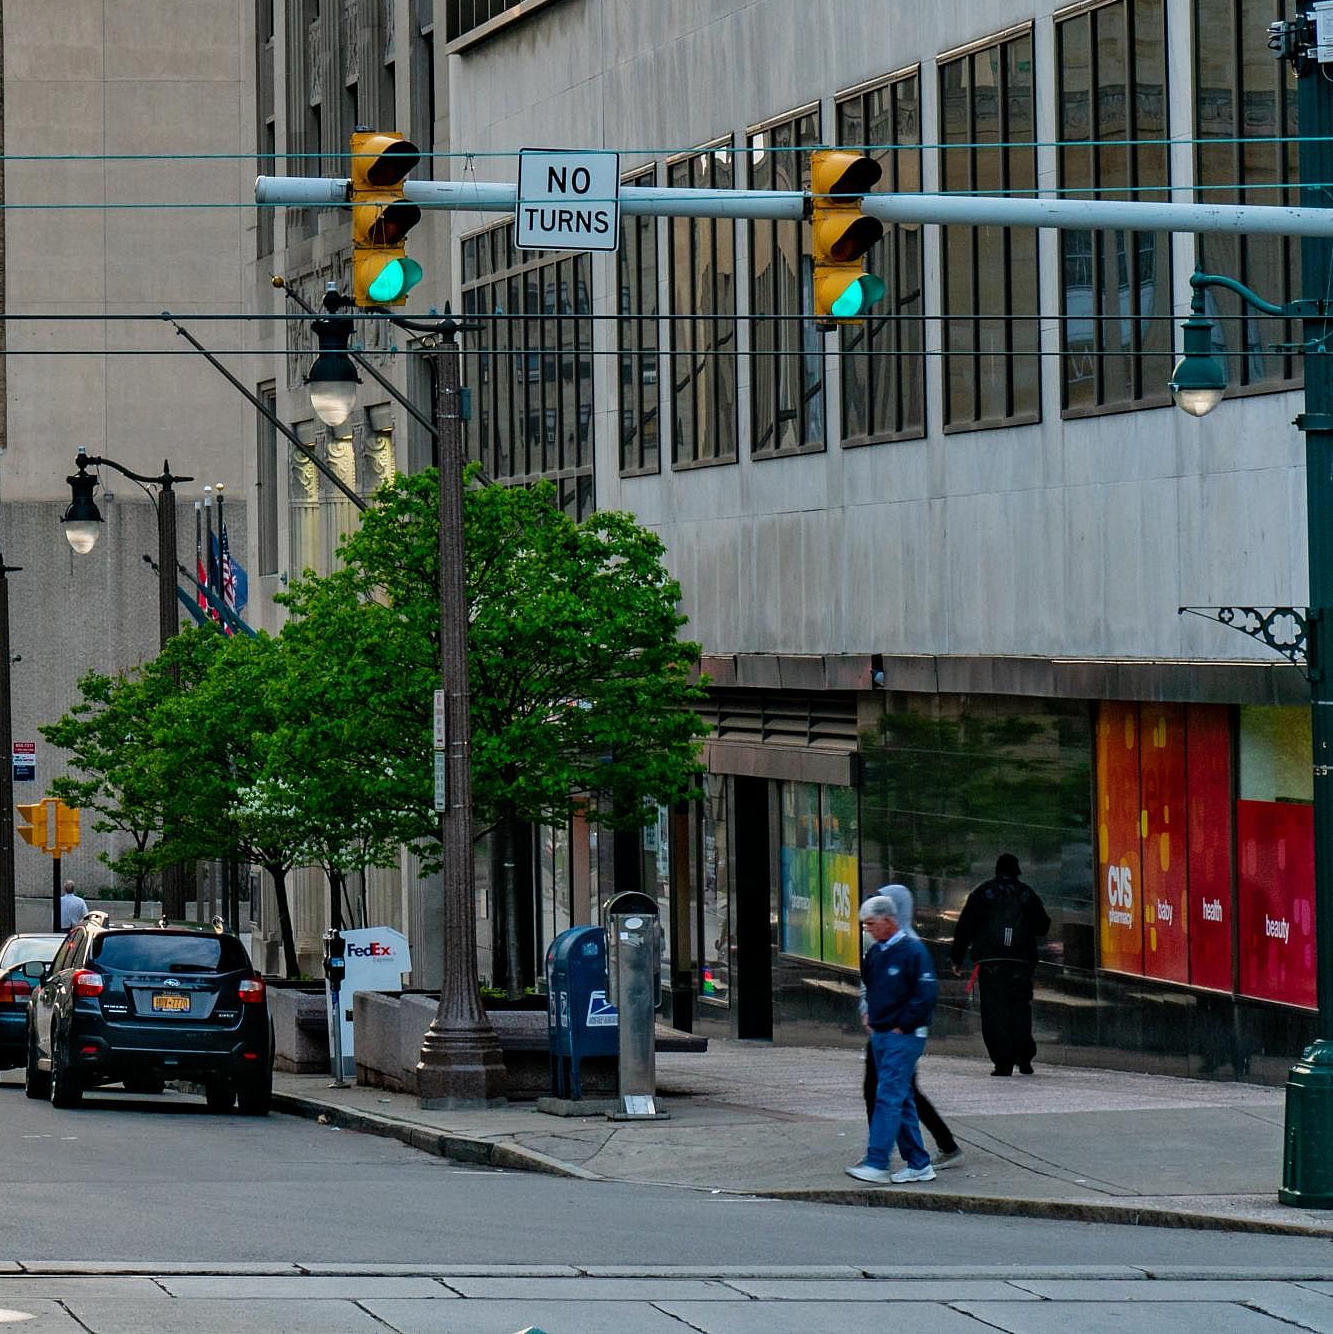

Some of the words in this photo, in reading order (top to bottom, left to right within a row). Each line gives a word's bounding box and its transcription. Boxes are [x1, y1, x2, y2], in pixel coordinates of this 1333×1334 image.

[548, 167, 590, 194] NO
[525, 209, 609, 233] TURNS
[833, 882, 851, 919] CVS
[1108, 866, 1133, 909] CVS
[1157, 898, 1173, 926] baby
[1202, 897, 1223, 923] health
[1265, 913, 1290, 945] beauty
[347, 942, 390, 957] FedEx
